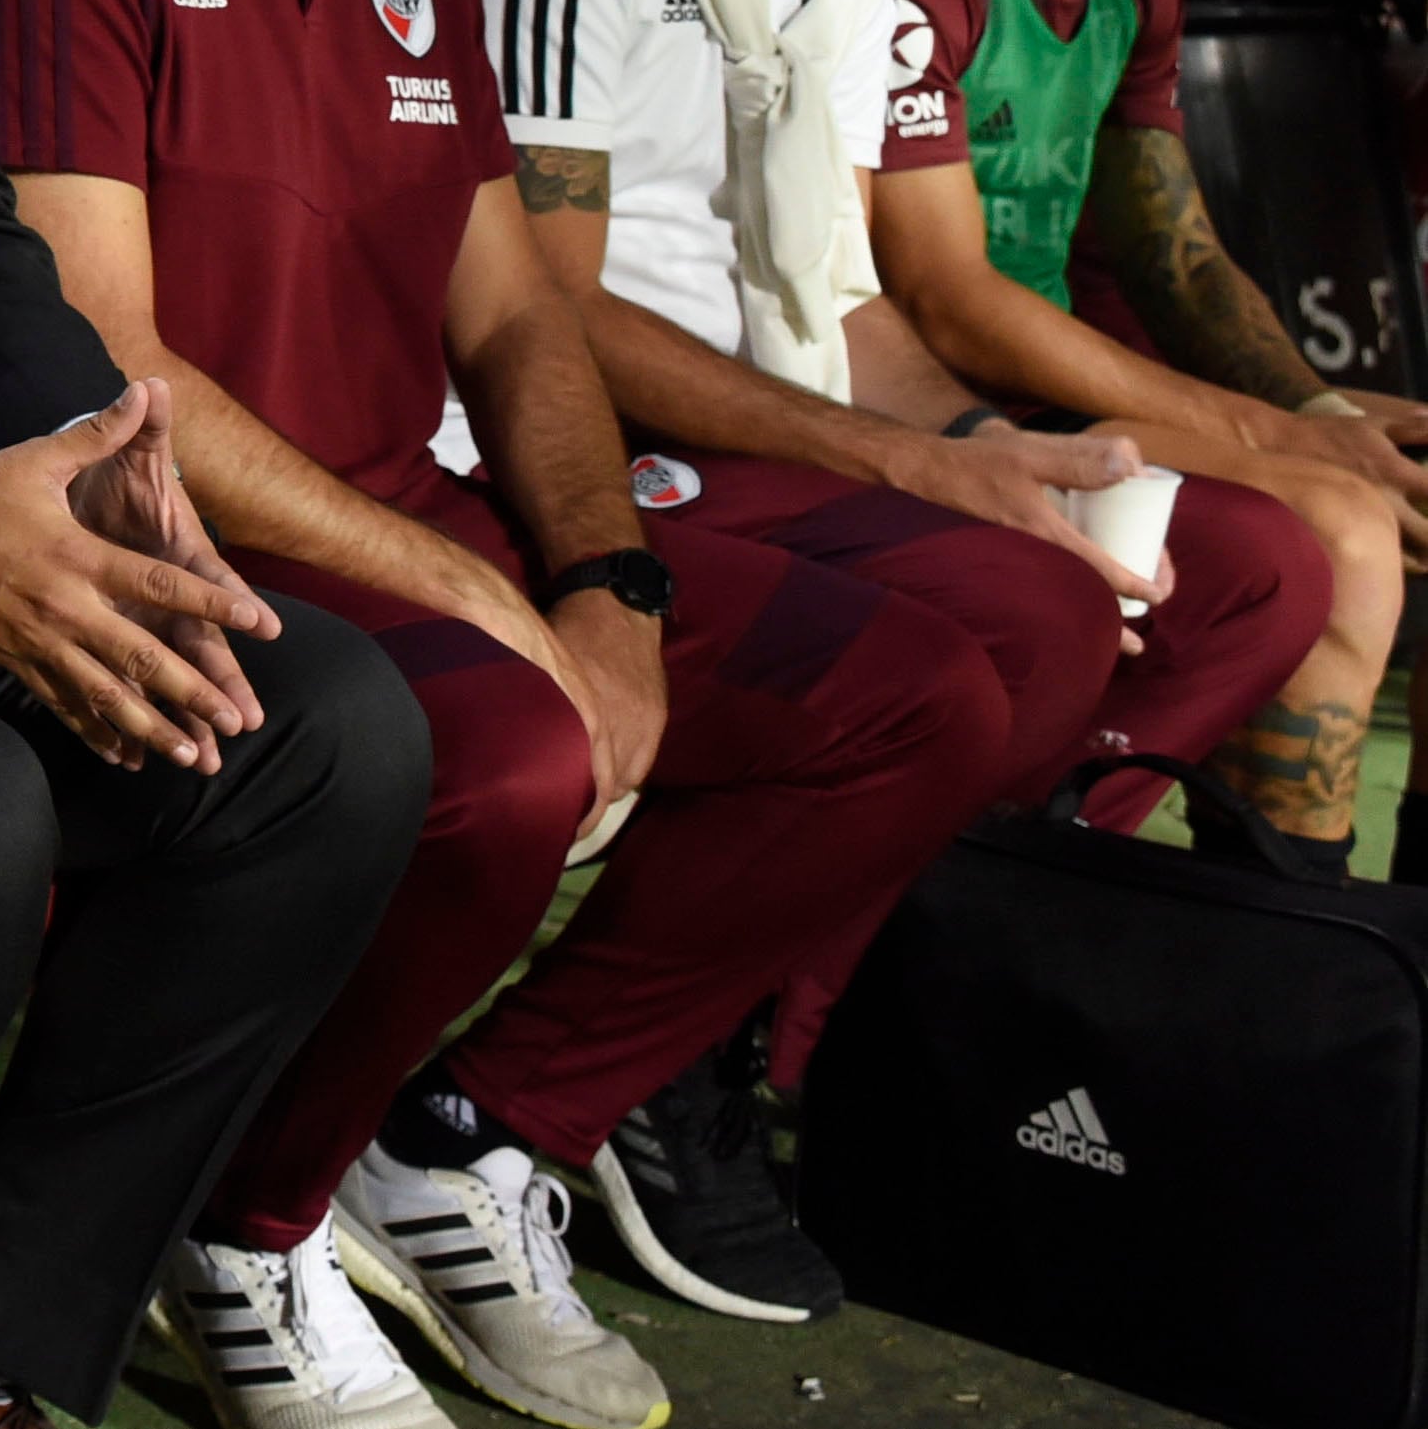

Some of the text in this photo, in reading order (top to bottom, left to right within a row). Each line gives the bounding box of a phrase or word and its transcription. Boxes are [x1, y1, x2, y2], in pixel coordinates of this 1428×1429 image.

[385, 76, 452, 100] TURKIS
[389, 99, 459, 125] AIRLIN
[1016, 1124, 1126, 1175] adidas
